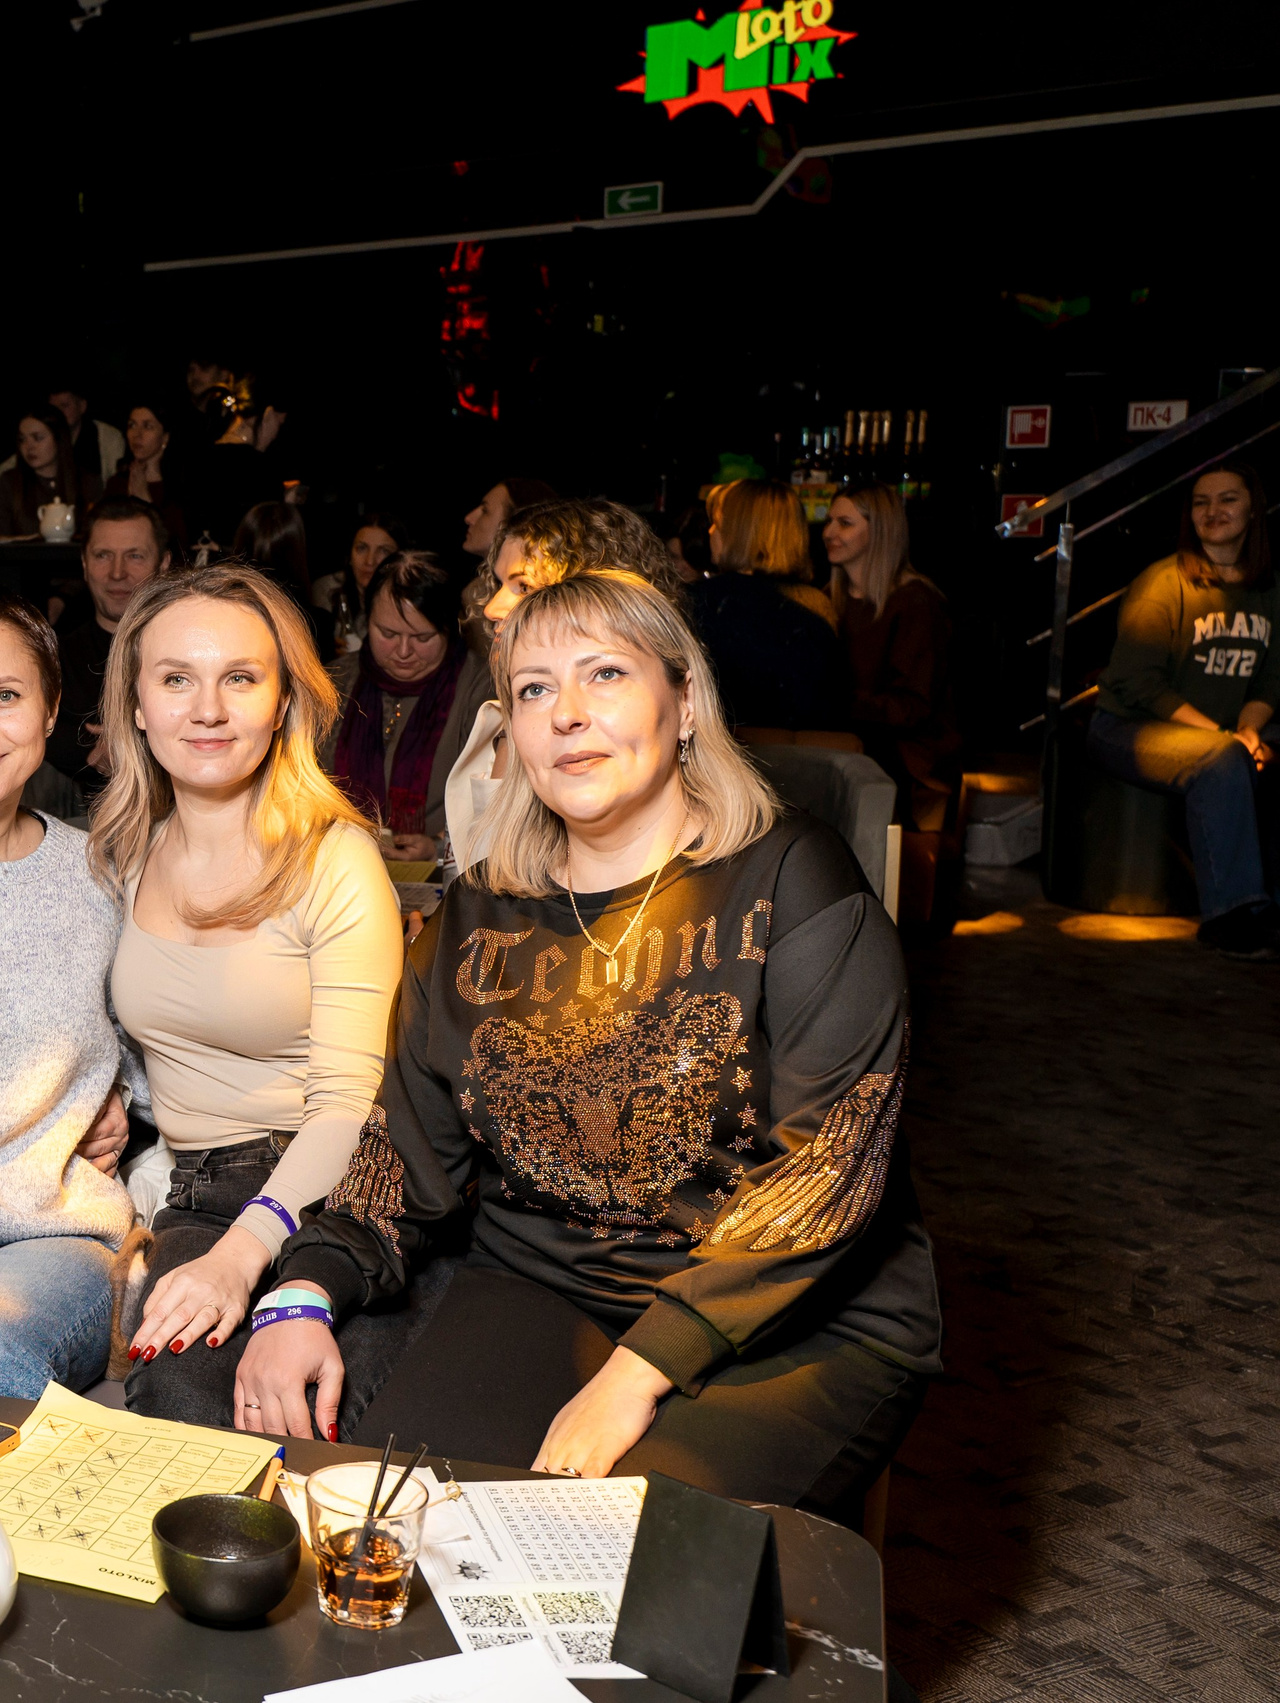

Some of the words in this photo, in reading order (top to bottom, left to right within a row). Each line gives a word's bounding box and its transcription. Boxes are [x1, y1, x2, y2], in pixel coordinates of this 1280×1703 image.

[734, 0, 834, 60] Loto
[644, 7, 836, 104] Mix
[1133, 406, 1171, 426] ПК-4
[270, 1200, 283, 1211] 297
[258, 1312, 278, 1325] CLUB
[287, 1307, 302, 1316] 296
[98, 1567, 156, 1586] MIXLOTO
